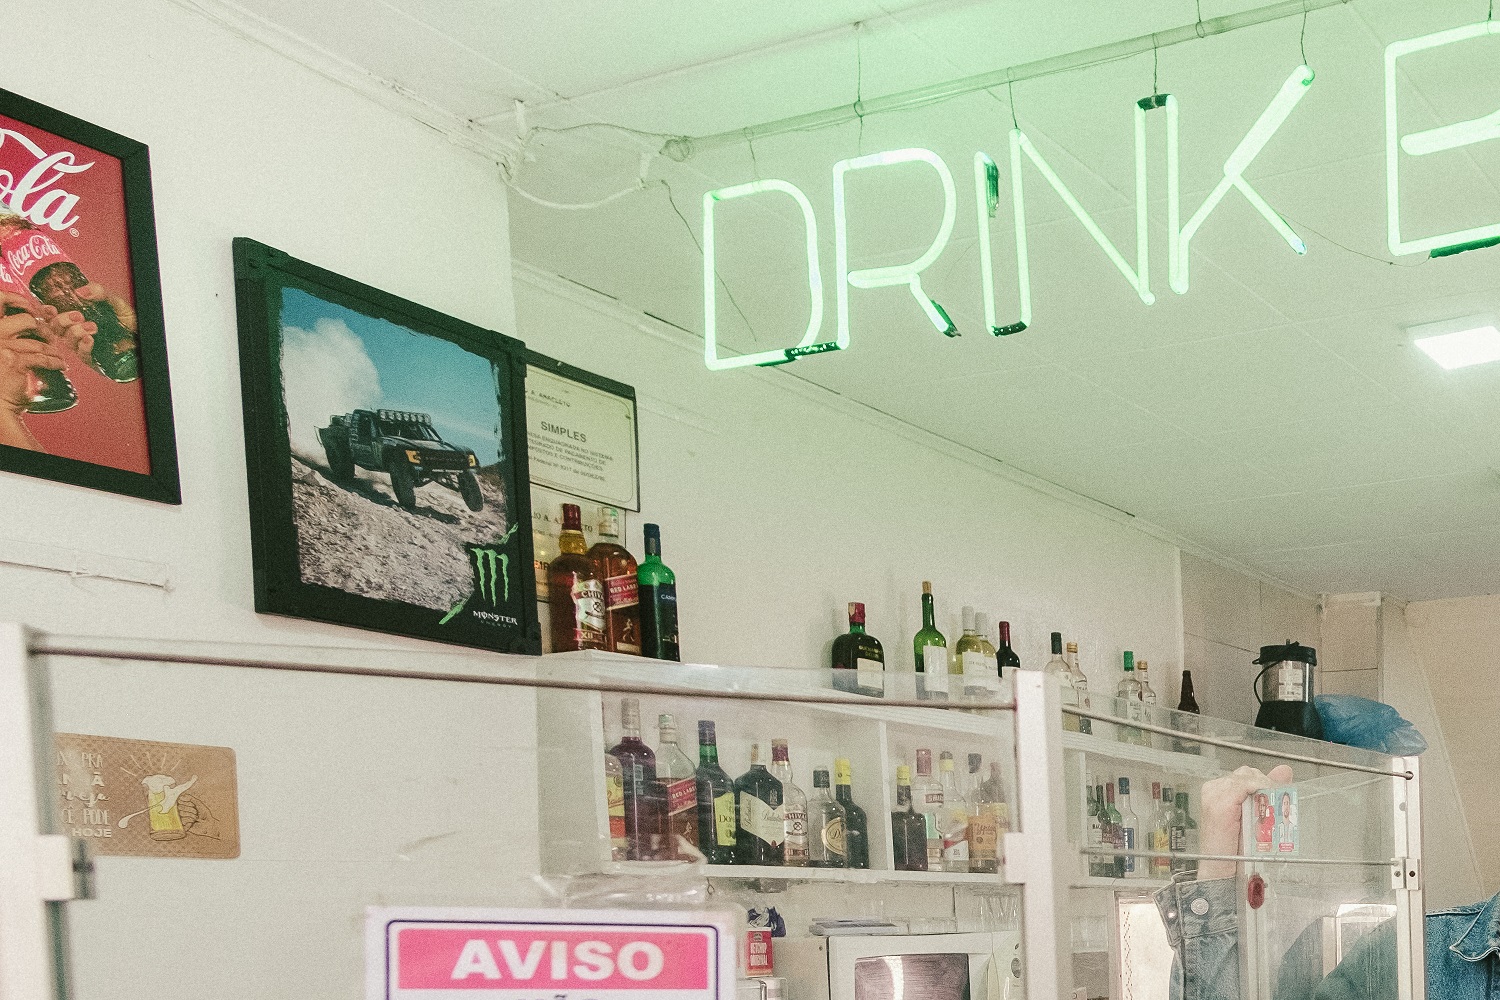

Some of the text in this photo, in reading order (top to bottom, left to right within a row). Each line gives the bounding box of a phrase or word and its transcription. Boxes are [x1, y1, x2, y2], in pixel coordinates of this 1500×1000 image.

[704, 64, 1315, 370] DRINK
[541, 421, 587, 443] SIMPLES
[473, 610, 518, 626] MONSTER
[71, 828, 112, 838] HOJE
[451, 938, 664, 981] AVISO
